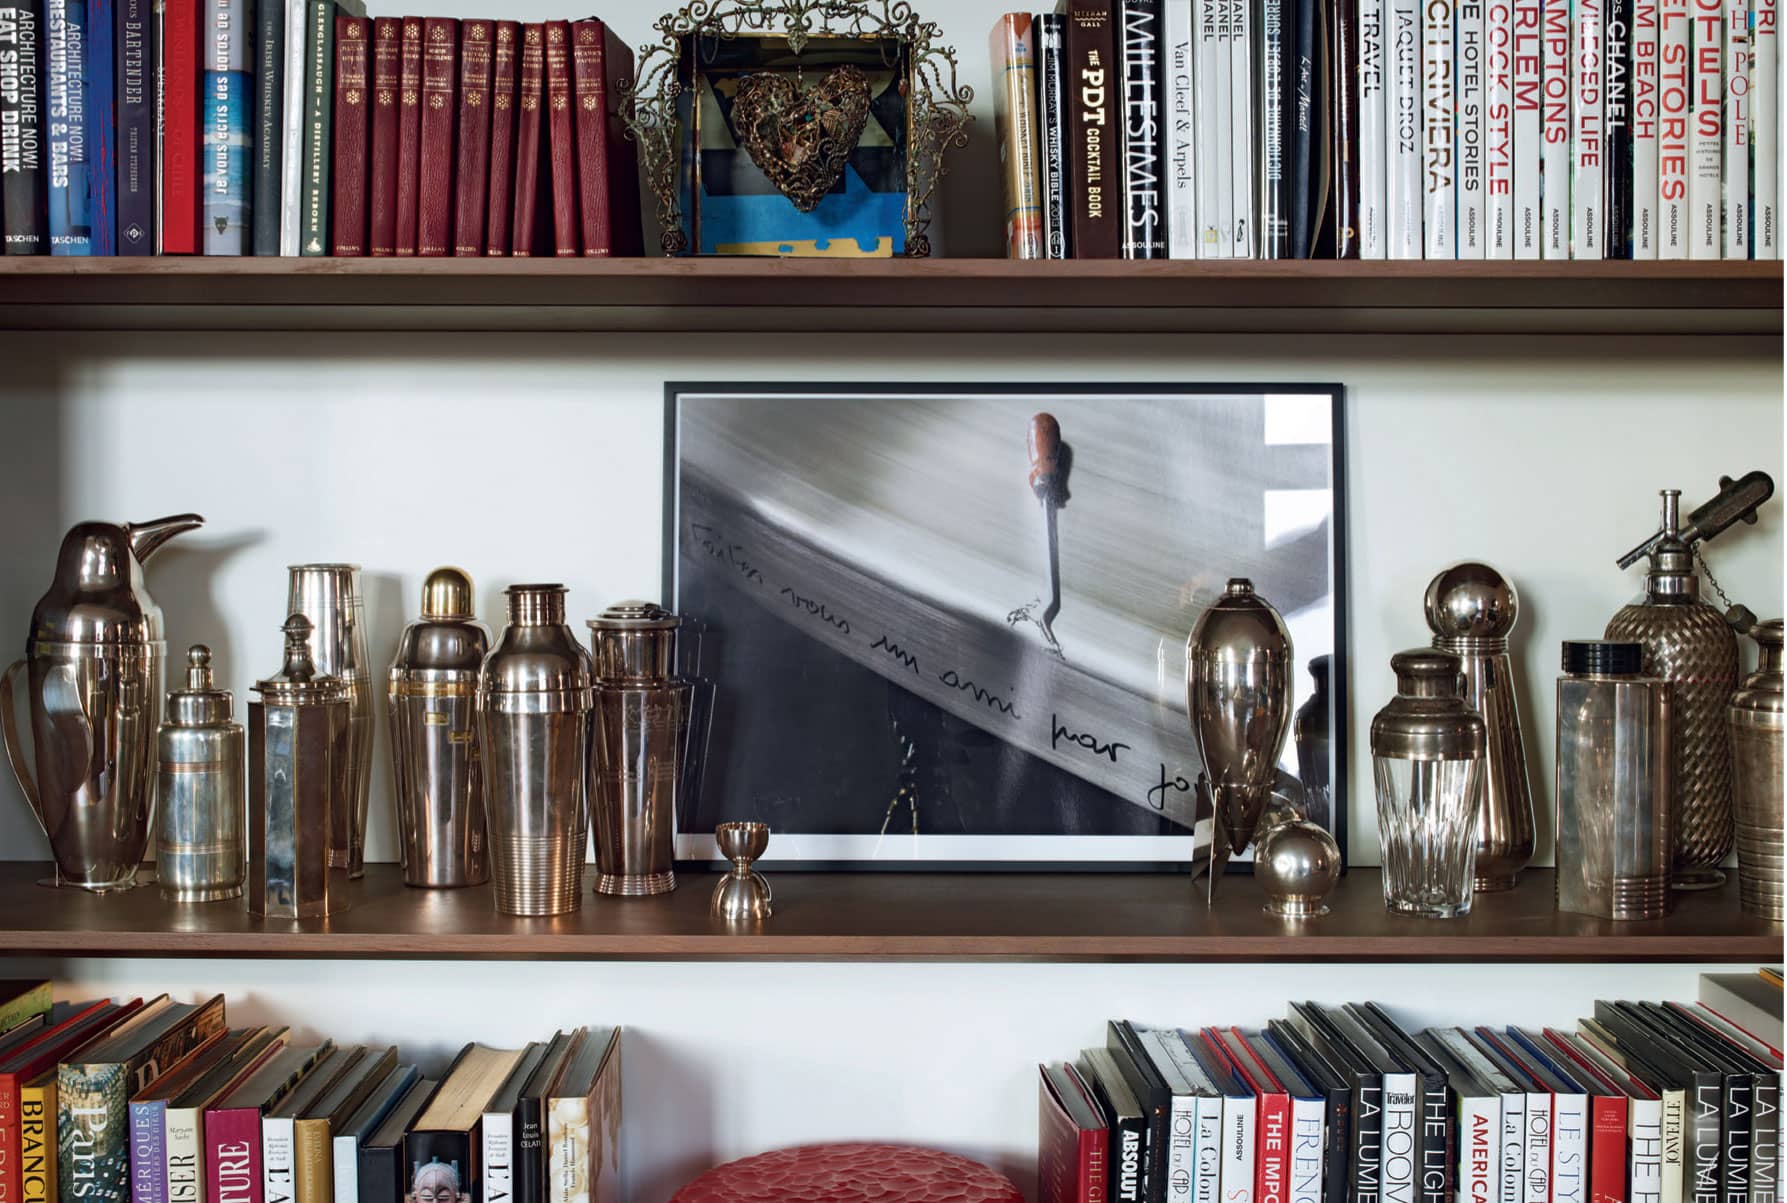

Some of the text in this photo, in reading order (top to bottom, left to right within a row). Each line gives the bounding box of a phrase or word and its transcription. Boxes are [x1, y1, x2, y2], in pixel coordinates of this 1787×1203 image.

[1204, 0, 1214, 42] ANEL
[1218, 0, 1229, 42] ANEL
[1233, 0, 1244, 42] ANEL
[126, 22, 142, 104] BARTENDER
[265, 39, 274, 70] IRISH
[316, 3, 325, 93] GLENGLASSAUGH
[1364, 9, 1380, 98] TRAVEL
[1515, 0, 1539, 111] RLEM
[1636, 0, 1655, 139] M BEACH
[0, 7, 20, 173] EAT SHOP DRINK
[19, 9, 38, 170] ARCHITECTURE NOW!
[49, 0, 68, 188] RESTAURANTS & BARS
[66, 22, 84, 162] ARCHITECTURE NOW!
[217, 76, 228, 100] des
[264, 72, 274, 120] WHISKEY
[1395, 9, 1415, 154] JAQUET DROZ
[1428, 0, 1451, 193] CH RIVIERA
[1462, 0, 1480, 192] E HOTEL STORIES
[1489, 4, 1509, 195] COCK STYLE
[1607, 21, 1626, 135] CHANEL
[1081, 49, 1105, 218] THE PDT COCKTAIL BOOK
[1173, 41, 1192, 189] Van Cleef & Arpels
[1661, 44, 1687, 200] STORIES
[217, 152, 228, 176] vous
[262, 120, 273, 169] ACADEMY
[312, 121, 322, 184] DISTILLERY
[1049, 126, 1059, 169] WHISKY
[1580, 116, 1599, 168] LIFE
[311, 189, 320, 232] REBORN
[1050, 171, 1059, 201] BIBLE
[5, 234, 39, 243] TASCHEN
[51, 235, 88, 245] TASCHEN
[1122, 241, 1166, 250] ASSOULINE
[1201, 1115, 1219, 1138] La
[1360, 1087, 1381, 1118] LA
[1425, 1086, 1447, 1137] THE
[1506, 1111, 1522, 1134] La
[1559, 1112, 1581, 1140] LE
[1698, 1086, 1720, 1118] LA
[1729, 1087, 1750, 1118] LA
[1755, 1086, 1777, 1117] LA
[72, 1104, 108, 1197] Paris
[1173, 1110, 1192, 1150] HOTEL
[1235, 1113, 1244, 1161] ASSOULINE
[1266, 1111, 1283, 1151] THE
[1528, 1109, 1548, 1149] HOTEL
[1635, 1116, 1661, 1178] THE
[1665, 1100, 1681, 1167] JONVELLE
[1120, 1130, 1140, 1201] ABSOLUT
[1471, 1114, 1489, 1203] AMERICA
